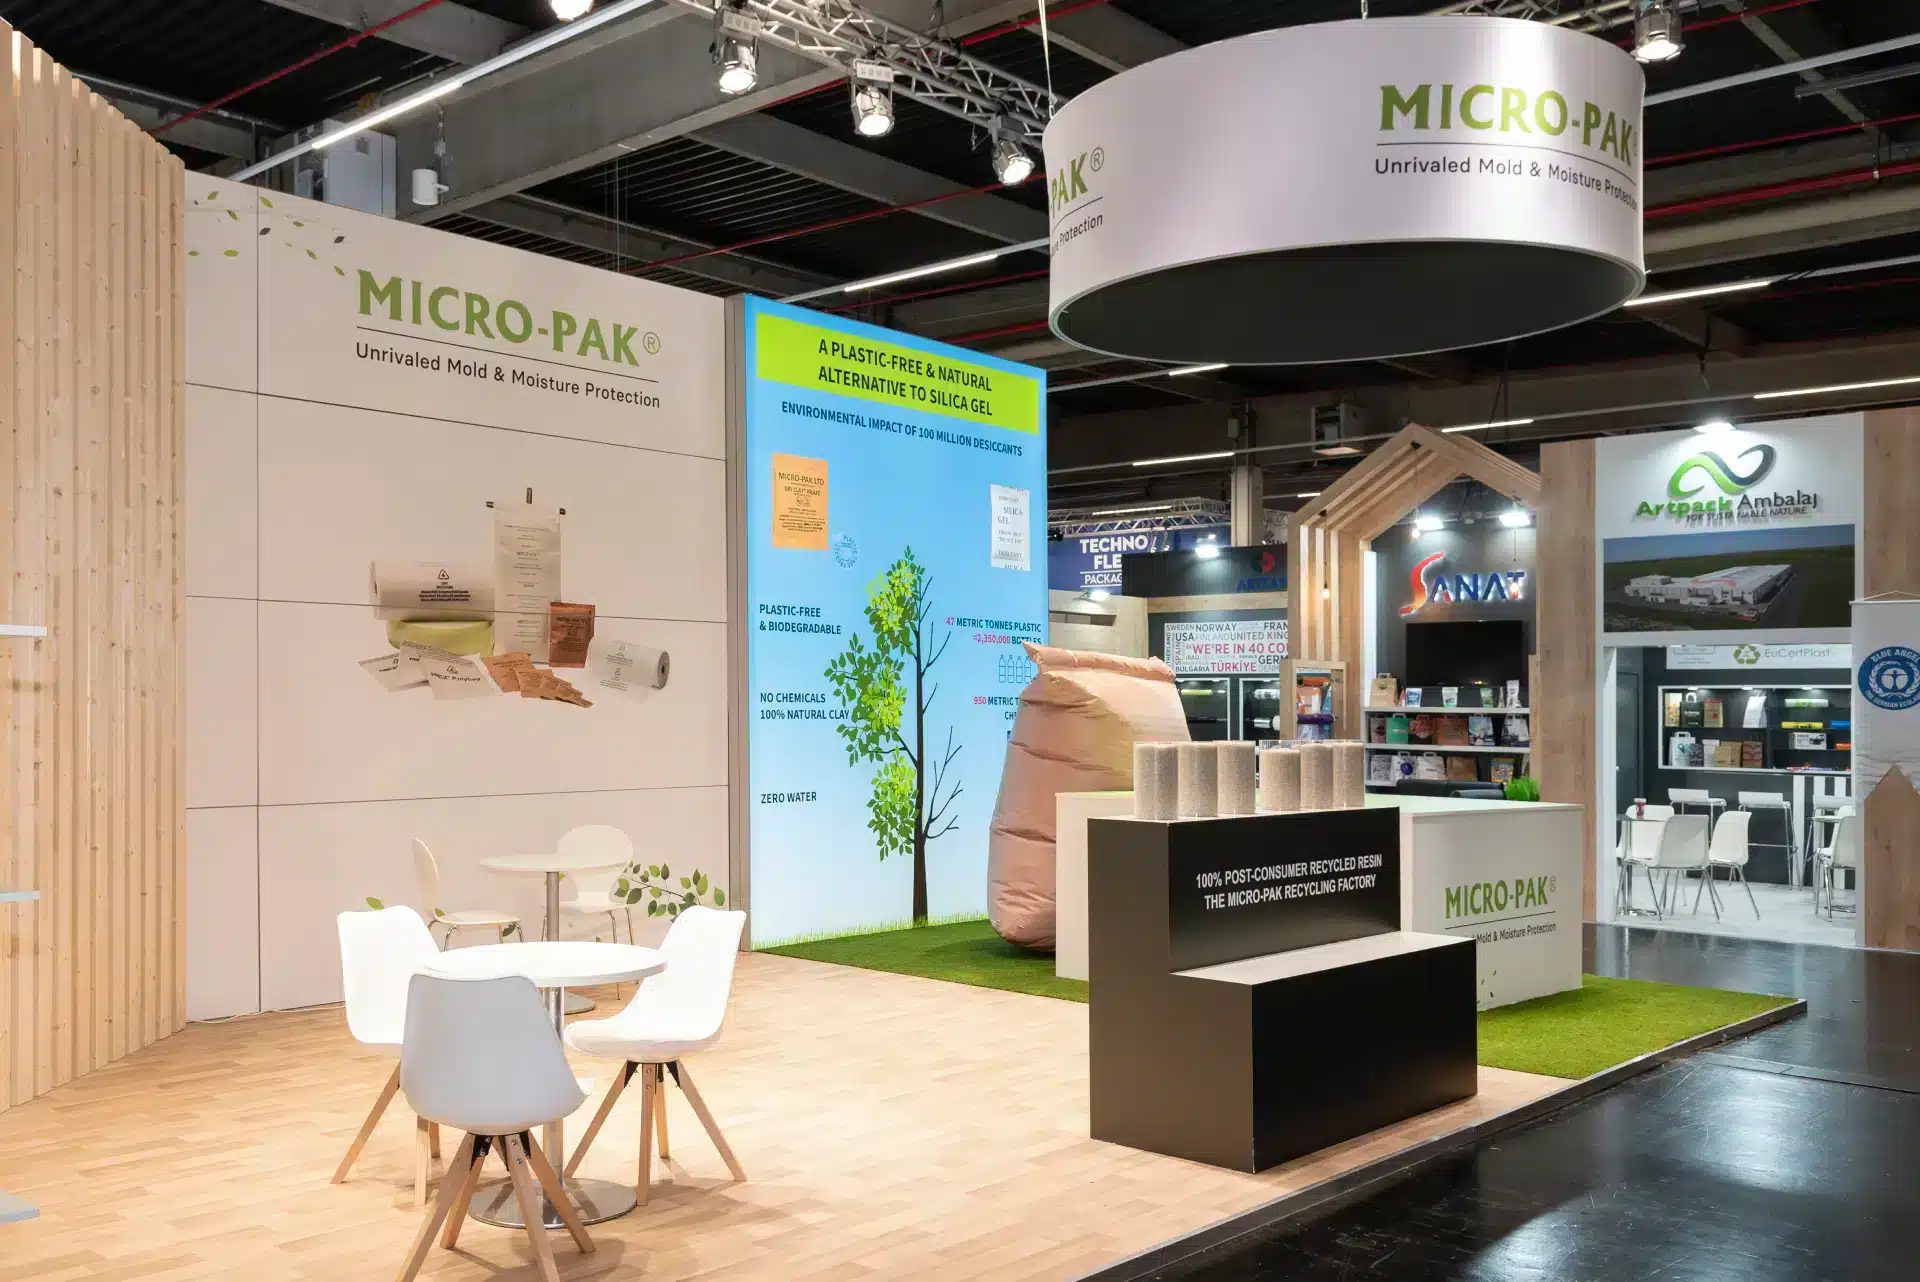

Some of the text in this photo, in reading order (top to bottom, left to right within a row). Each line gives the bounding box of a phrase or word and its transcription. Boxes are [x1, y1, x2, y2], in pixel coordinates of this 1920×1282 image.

[1375, 156, 1470, 174] Unrivaled
[1479, 158, 1522, 175] Mold
[1530, 162, 1540, 177] &
[1549, 164, 1601, 191] Moisture
[1060, 214, 1103, 245] Protection
[818, 338, 992, 392] A PLASTIC-FREE & NATURAL
[356, 341, 660, 408] Unrivaled Mold & Moisture Protection
[818, 365, 992, 416] ALTERNATIVE TO SILICA GEL
[781, 401, 1023, 457] ENVIRONMENTAL IMPACT OF 100 MILLION DESICCANTS
[778, 472, 813, 484] MICRO-PAK
[814, 478, 825, 486] LTD
[1737, 479, 1818, 509] Ambalaj
[1707, 508, 1765, 520] SUSTANABLE
[1080, 534, 1148, 553] TECHNO
[1094, 553, 1122, 570] FLE
[1398, 552, 1526, 617] SANAT
[759, 603, 821, 618] PLASTIC-FREE
[759, 620, 842, 635] & BIODEGRADABLE
[956, 617, 983, 628] METRIC
[985, 619, 1013, 631] TONNES
[1014, 622, 1041, 633] PLASTIC
[1195, 623, 1237, 632] NORWAY
[1175, 632, 1195, 641] USA
[1230, 631, 1264, 640] UNITED
[1233, 643, 1245, 654] IN
[1248, 643, 1264, 654] 40
[1268, 642, 1288, 654] CO
[1764, 647, 1831, 658] EuCertPlast
[1870, 649, 1893, 663] BLUE
[760, 692, 826, 703] NO CHEMICALS
[988, 697, 1014, 706] METRIC
[760, 709, 850, 720] 100% NATURAL CLAY
[760, 791, 817, 804] ZERO WATER
[1196, 853, 1382, 889] 100% POST-CONSUMER RECYCLED RESIN
[1204, 874, 1377, 910] THE MICRO-PAK RECYCLING FACTORY
[1476, 931, 1491, 944] Mold
[1493, 930, 1498, 941] &
[1499, 927, 1526, 940] Moisture
[1526, 922, 1557, 936] Protection
